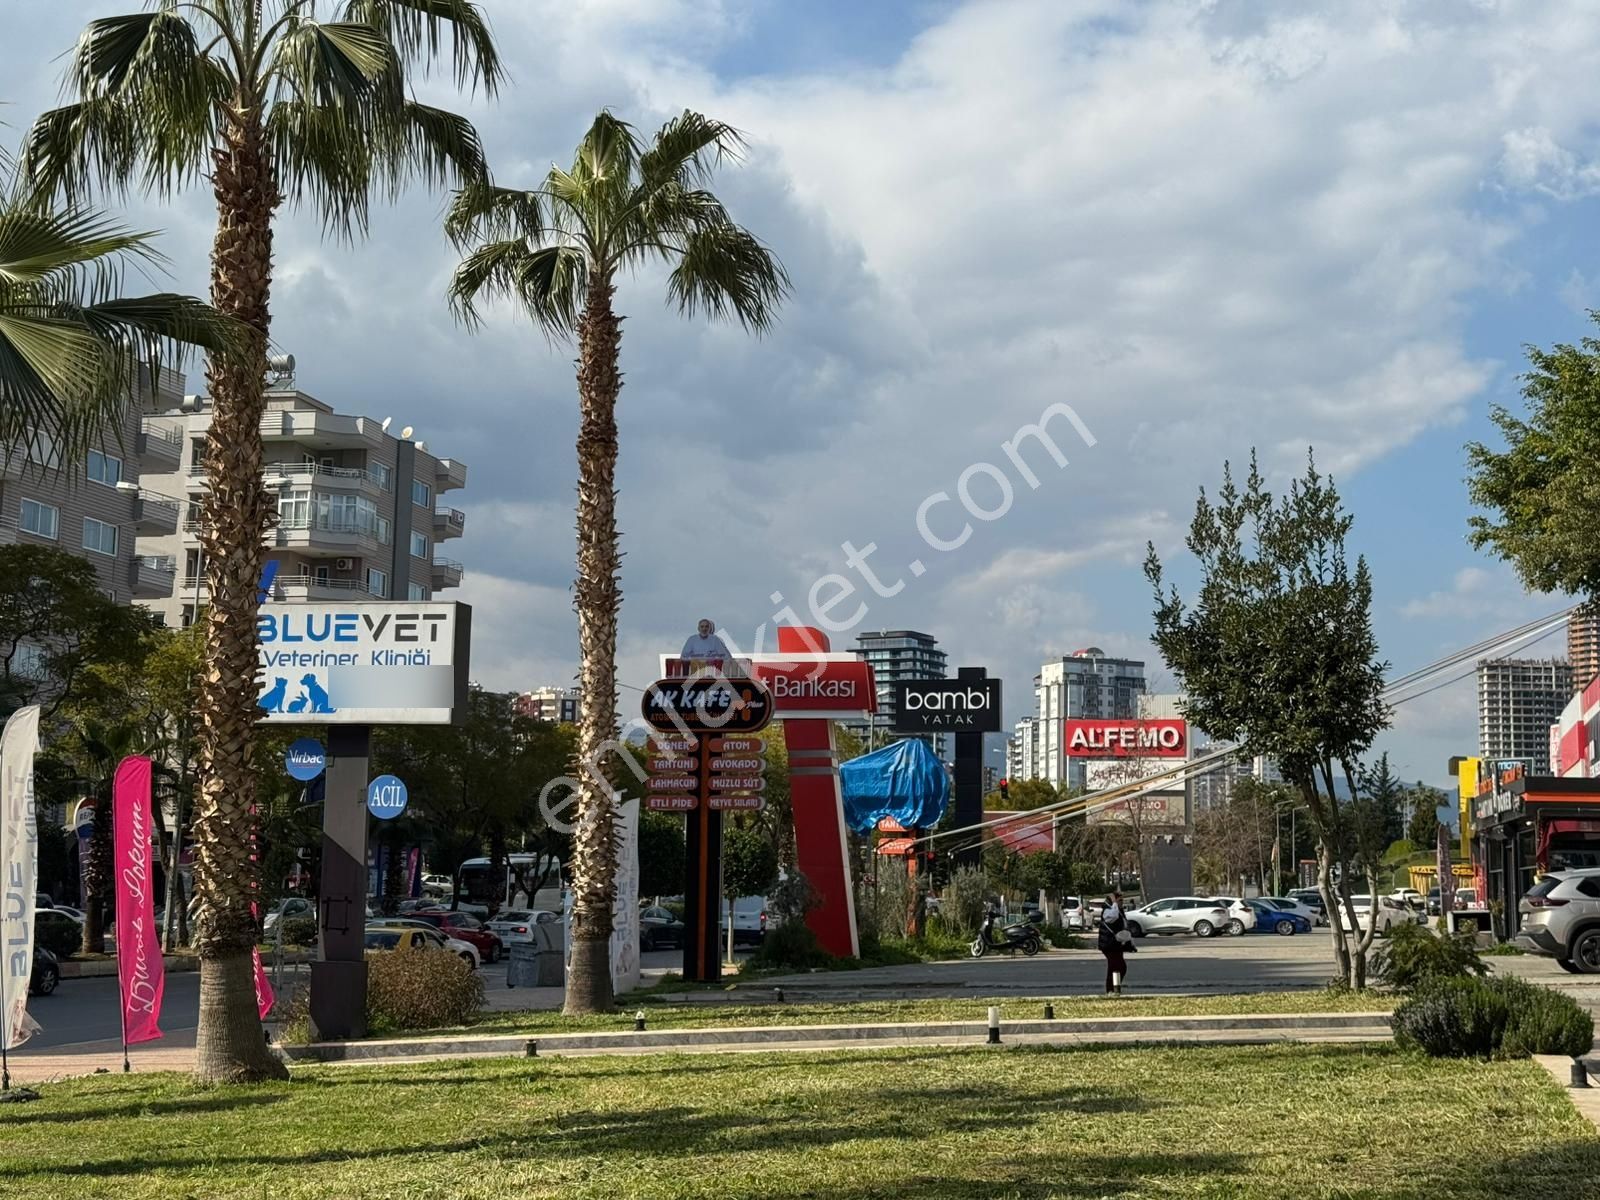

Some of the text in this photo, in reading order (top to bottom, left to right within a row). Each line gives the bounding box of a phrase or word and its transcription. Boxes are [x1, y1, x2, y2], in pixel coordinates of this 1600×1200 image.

[257, 613, 447, 642] BLUEVET
[263, 650, 359, 667] Veteriner
[774, 675, 856, 697] Bankası
[650, 690, 677, 708] AK
[905, 686, 990, 710] bambi
[921, 714, 974, 725] YATAK
[1069, 726, 1180, 748] ALFEMO
[723, 741, 750, 750] ATOM
[289, 749, 324, 764] Virbac
[712, 758, 758, 769] AVOKADO
[650, 779, 696, 788] LAHMACUN
[712, 779, 741, 788] MUZLU
[370, 779, 404, 807] ACİL
[650, 797, 693, 807] ETLİ PİDE
[709, 799, 732, 807] MEYVE
